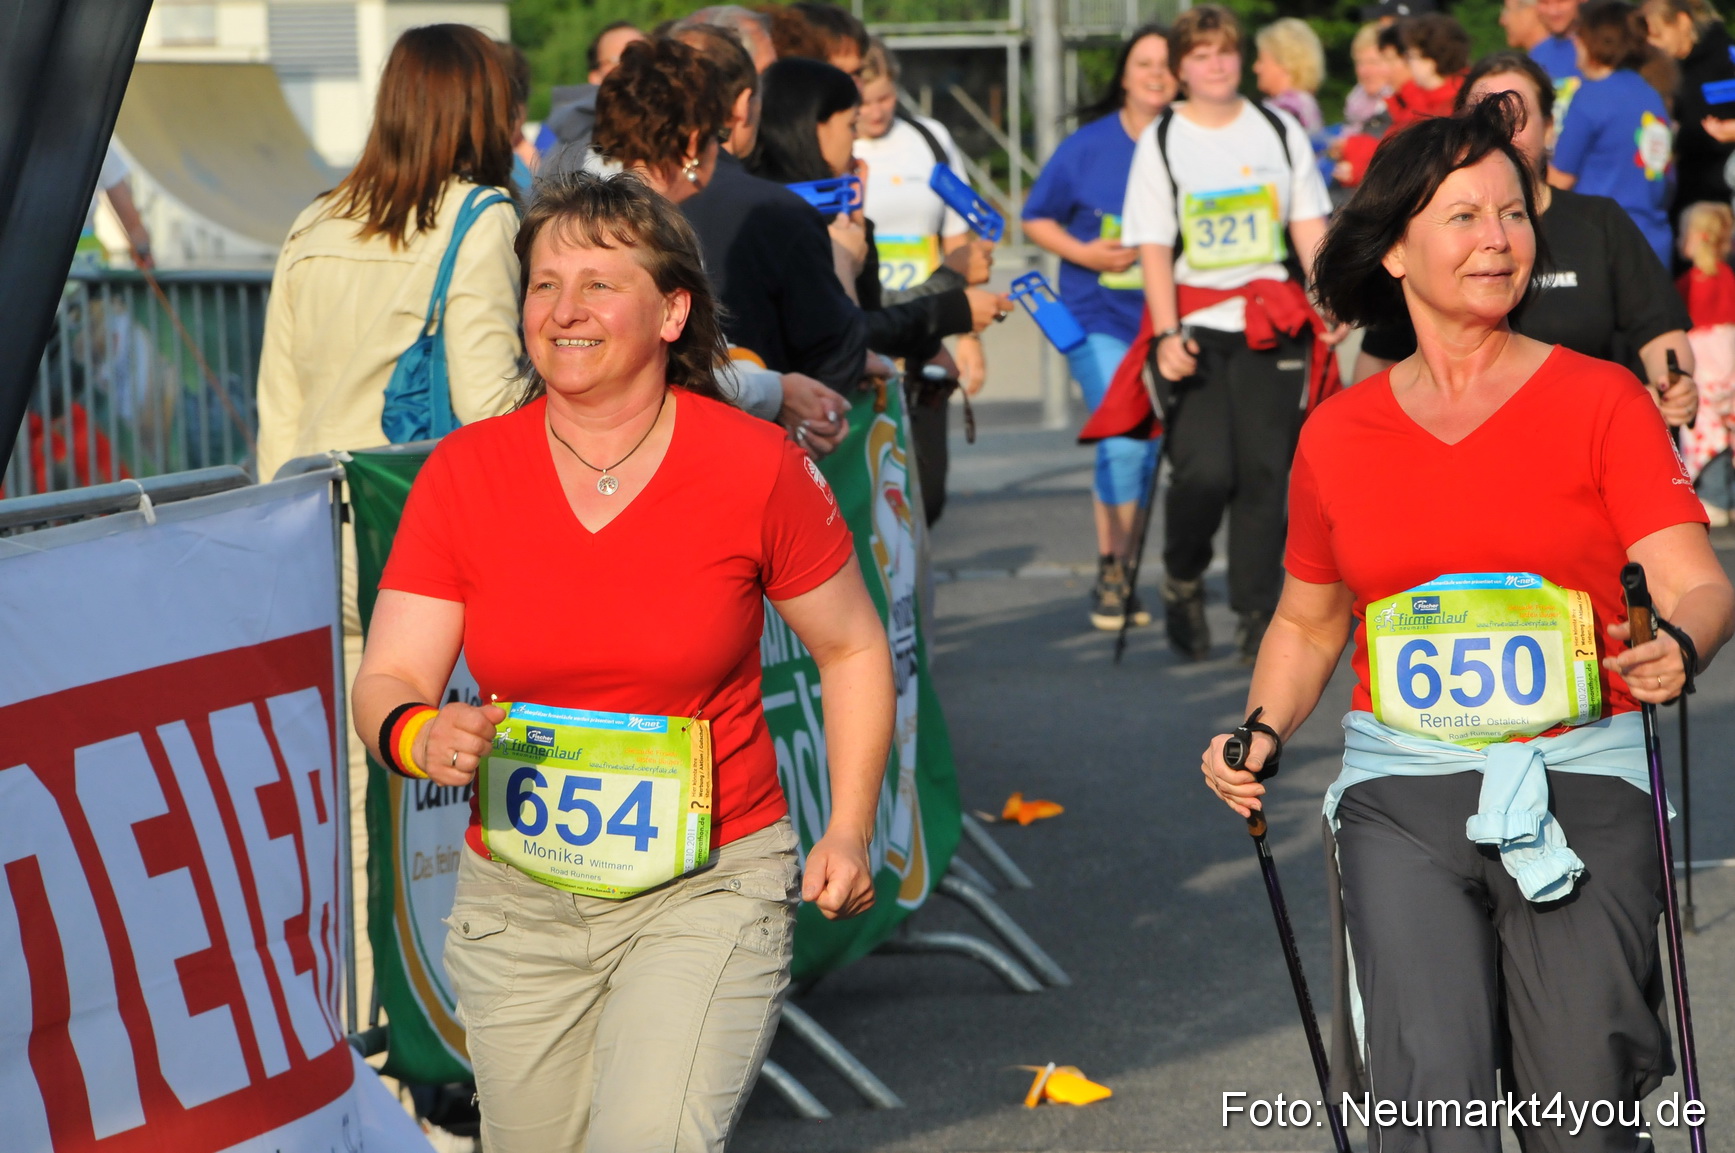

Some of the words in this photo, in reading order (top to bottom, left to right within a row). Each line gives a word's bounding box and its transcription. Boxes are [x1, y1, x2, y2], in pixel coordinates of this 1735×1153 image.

[1197, 213, 1257, 248] 321
[1399, 611, 1469, 626] firmenlauf
[1397, 635, 1546, 709] 650
[1576, 676, 1588, 709] 3.10.2011
[1420, 713, 1481, 729] Renate
[1449, 732, 1468, 740] Road
[512, 739, 583, 760] firmenlauf
[506, 766, 658, 852] 654
[523, 840, 584, 866] Monika
[589, 858, 634, 872] Wittmann
[685, 829, 696, 863] 3.10.2011
[550, 866, 569, 876] Road
[570, 870, 602, 881] Runners
